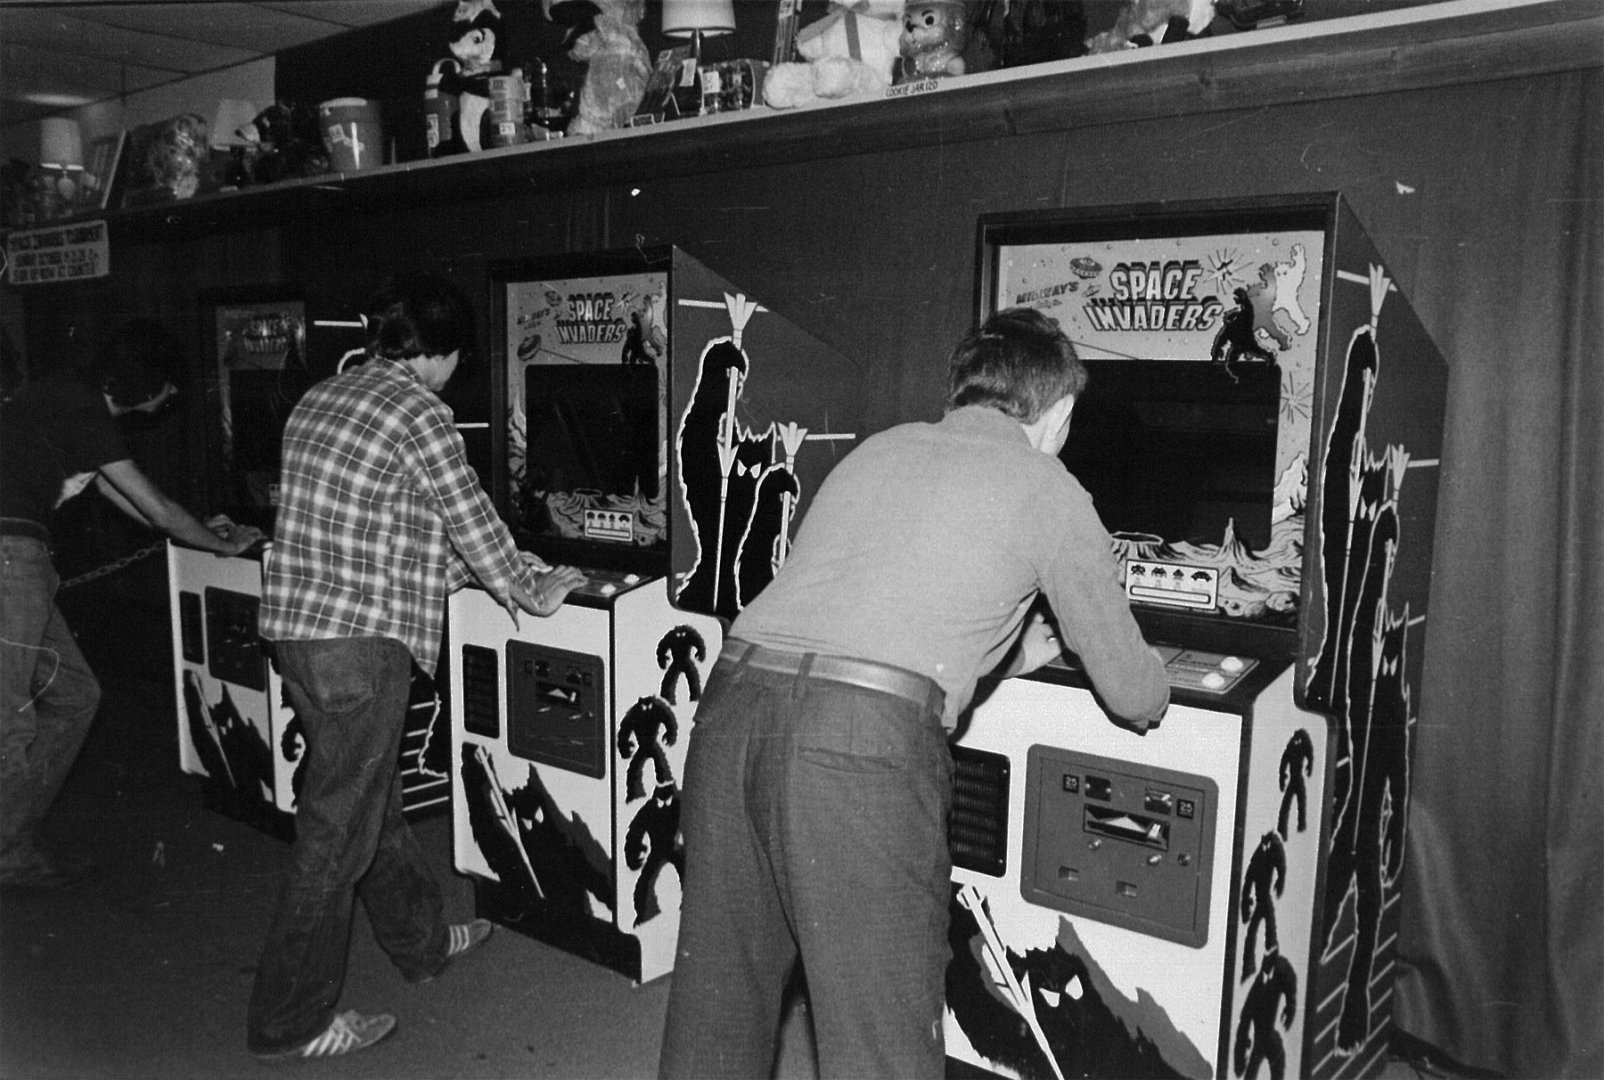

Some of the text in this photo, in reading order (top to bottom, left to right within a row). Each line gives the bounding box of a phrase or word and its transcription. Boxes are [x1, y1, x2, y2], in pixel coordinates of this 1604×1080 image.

[885, 84, 909, 98] COOKIE
[911, 82, 925, 94] JAR
[1110, 260, 1204, 301] SPACE
[567, 292, 615, 321] SPACE
[1083, 298, 1224, 332] INVADERS
[554, 317, 626, 344] INVADERS
